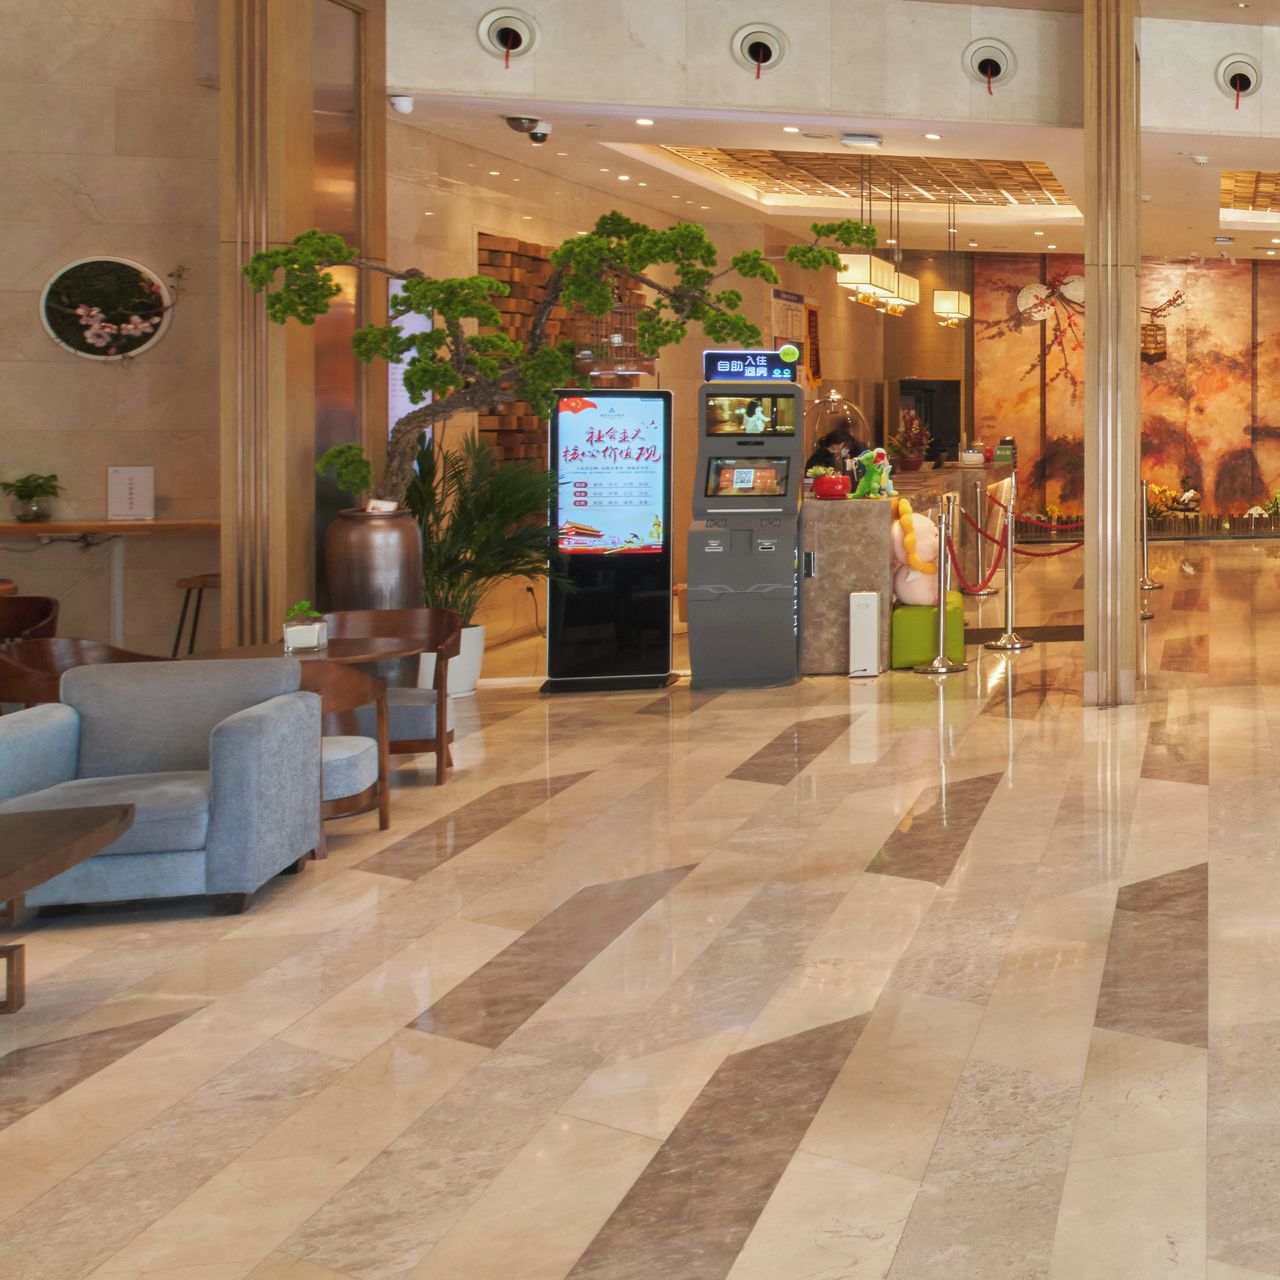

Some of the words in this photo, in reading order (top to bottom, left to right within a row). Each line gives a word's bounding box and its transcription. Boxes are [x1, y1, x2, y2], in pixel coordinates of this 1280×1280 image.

[717, 360, 744, 372] 自助
[744, 355, 768, 366] 入住
[586, 426, 646, 446] 社会主义
[562, 444, 662, 464] 核心价值观
